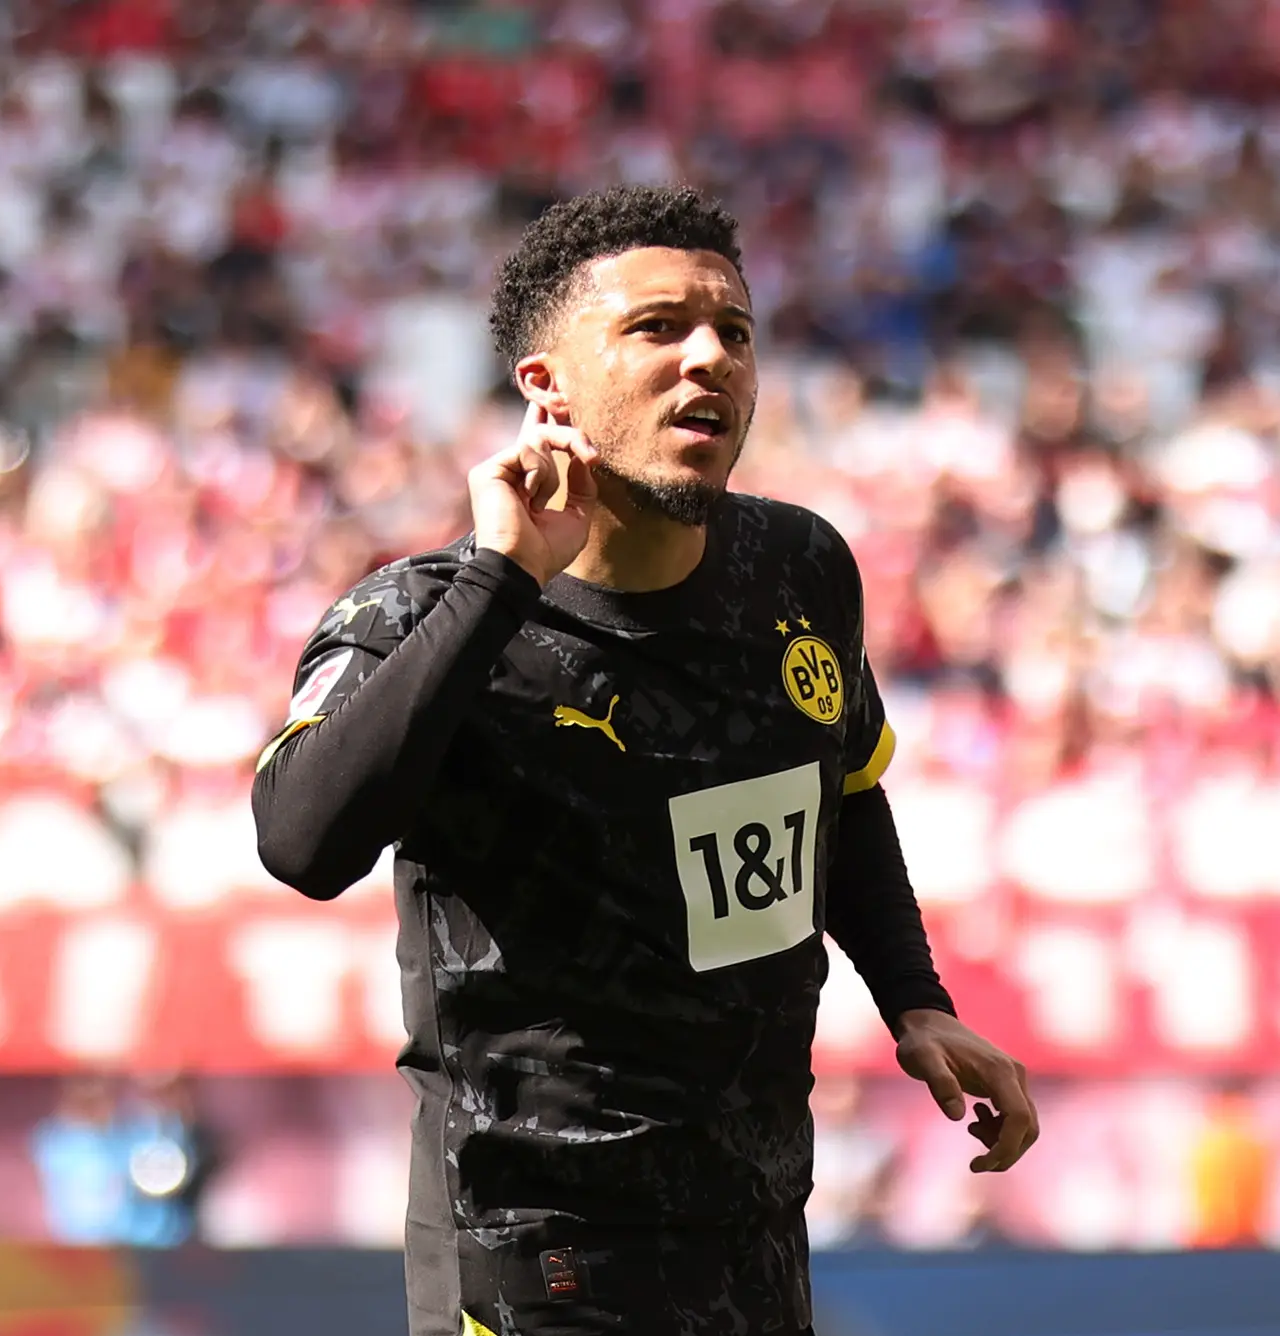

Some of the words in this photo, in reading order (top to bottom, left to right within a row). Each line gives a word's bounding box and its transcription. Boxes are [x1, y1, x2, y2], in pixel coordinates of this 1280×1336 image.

[791, 645, 839, 701] BVB
[817, 696, 834, 715] 09
[689, 809, 806, 920] 1&1
